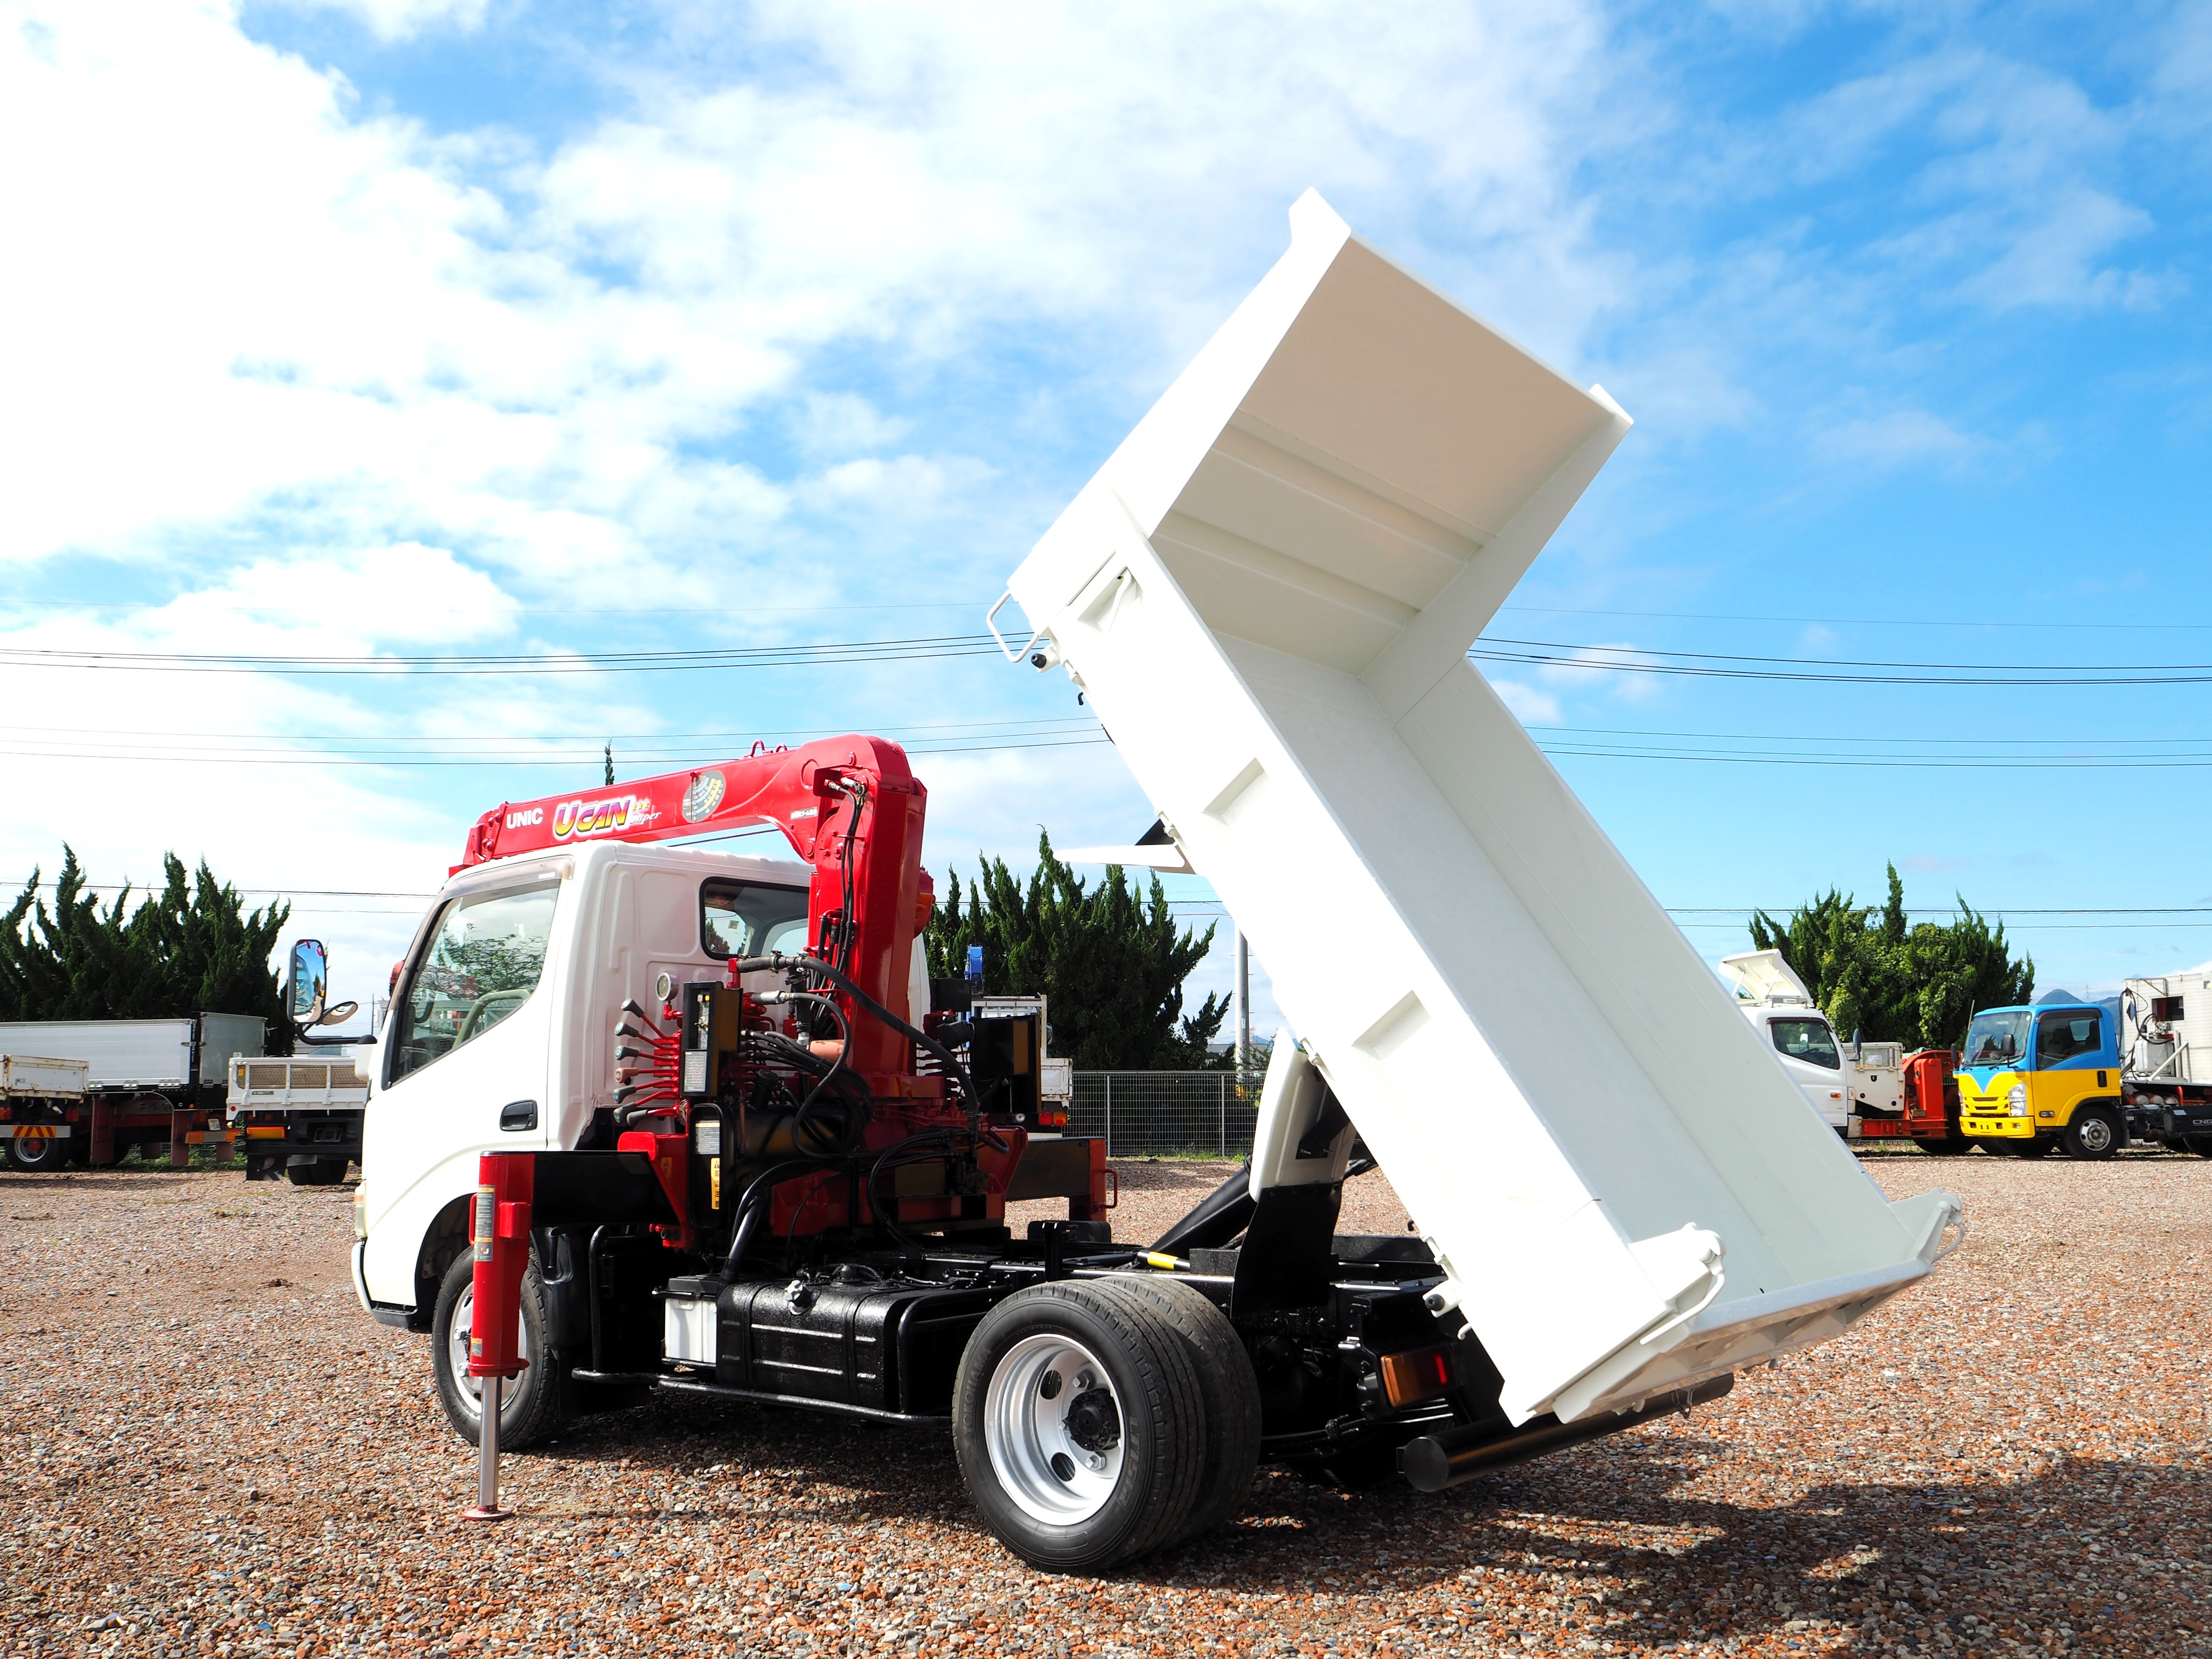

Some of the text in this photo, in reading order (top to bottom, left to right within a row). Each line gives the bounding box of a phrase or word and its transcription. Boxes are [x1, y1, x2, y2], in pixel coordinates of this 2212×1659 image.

[506, 807, 543, 829] UNIC
[630, 811, 662, 825] Super
[963, 1347, 992, 1435] YOKOHAMA
